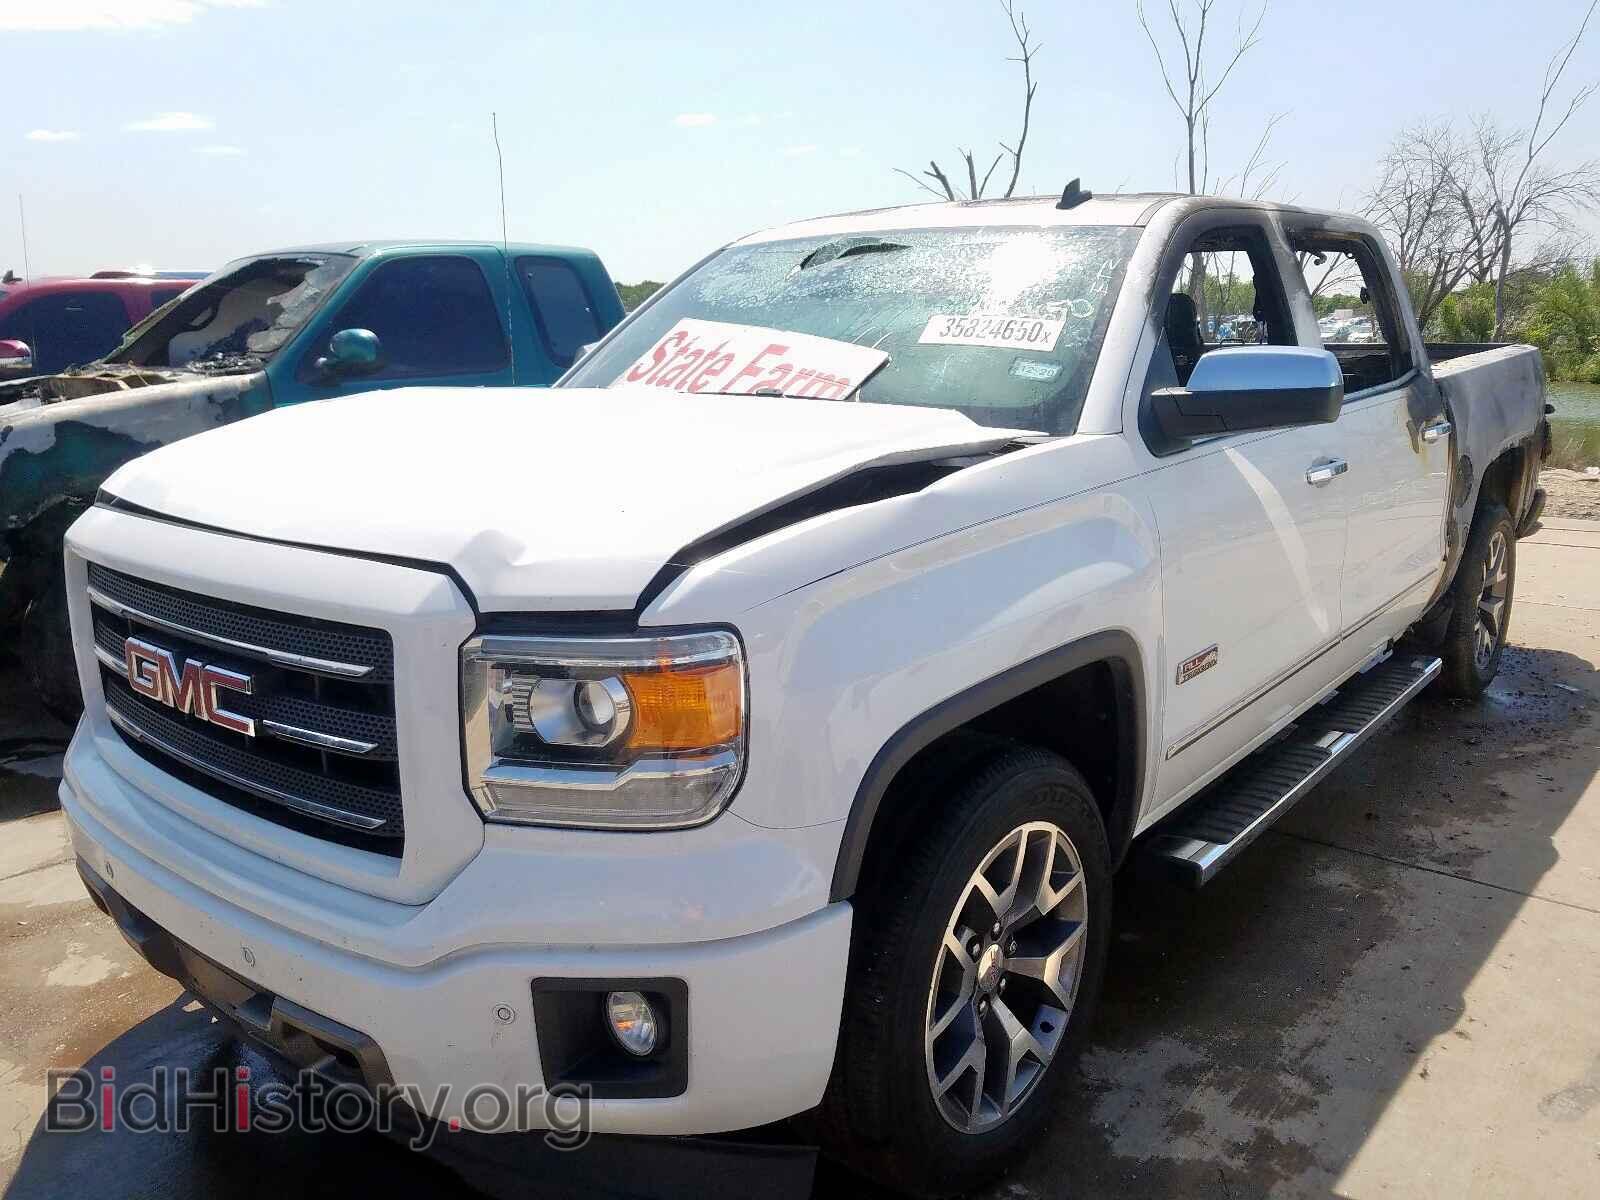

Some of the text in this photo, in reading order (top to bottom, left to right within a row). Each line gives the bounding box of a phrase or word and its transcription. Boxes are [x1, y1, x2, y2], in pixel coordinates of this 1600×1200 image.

[626, 330, 850, 399] State Farm
[124, 636, 256, 738] GMC
